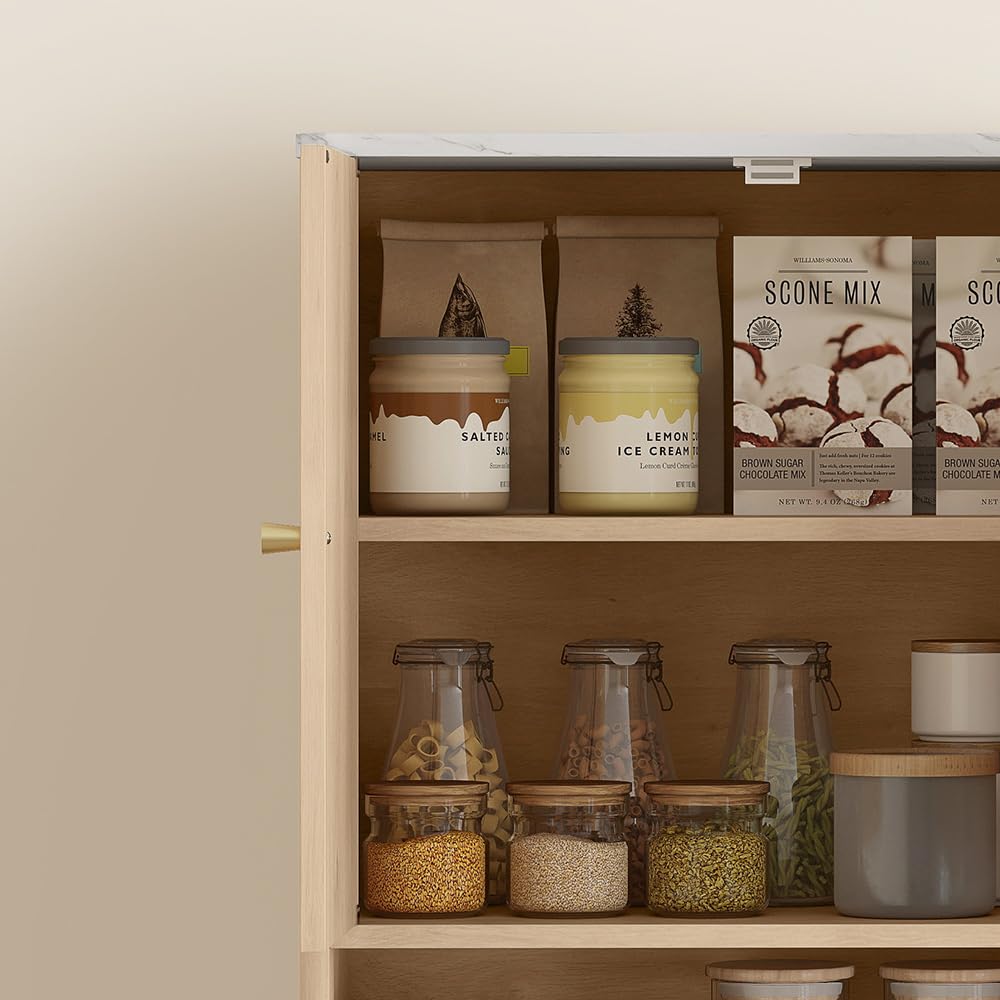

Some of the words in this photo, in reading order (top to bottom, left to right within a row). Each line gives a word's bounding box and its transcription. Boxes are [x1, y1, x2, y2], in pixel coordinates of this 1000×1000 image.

[765, 280, 834, 305] SCONE
[844, 280, 881, 305] MIX
[461, 432, 504, 442] SALTED
[646, 432, 688, 442] LEMON
[618, 446, 642, 456] ICE
[649, 446, 689, 456] CREAM
[742, 458, 774, 468] BROWN
[775, 458, 804, 468] SUGAR
[944, 458, 977, 468] BROWN
[740, 470, 789, 479] CHOCOLATE
[790, 470, 806, 479] MIX
[942, 470, 991, 479] CHOCOLATE
